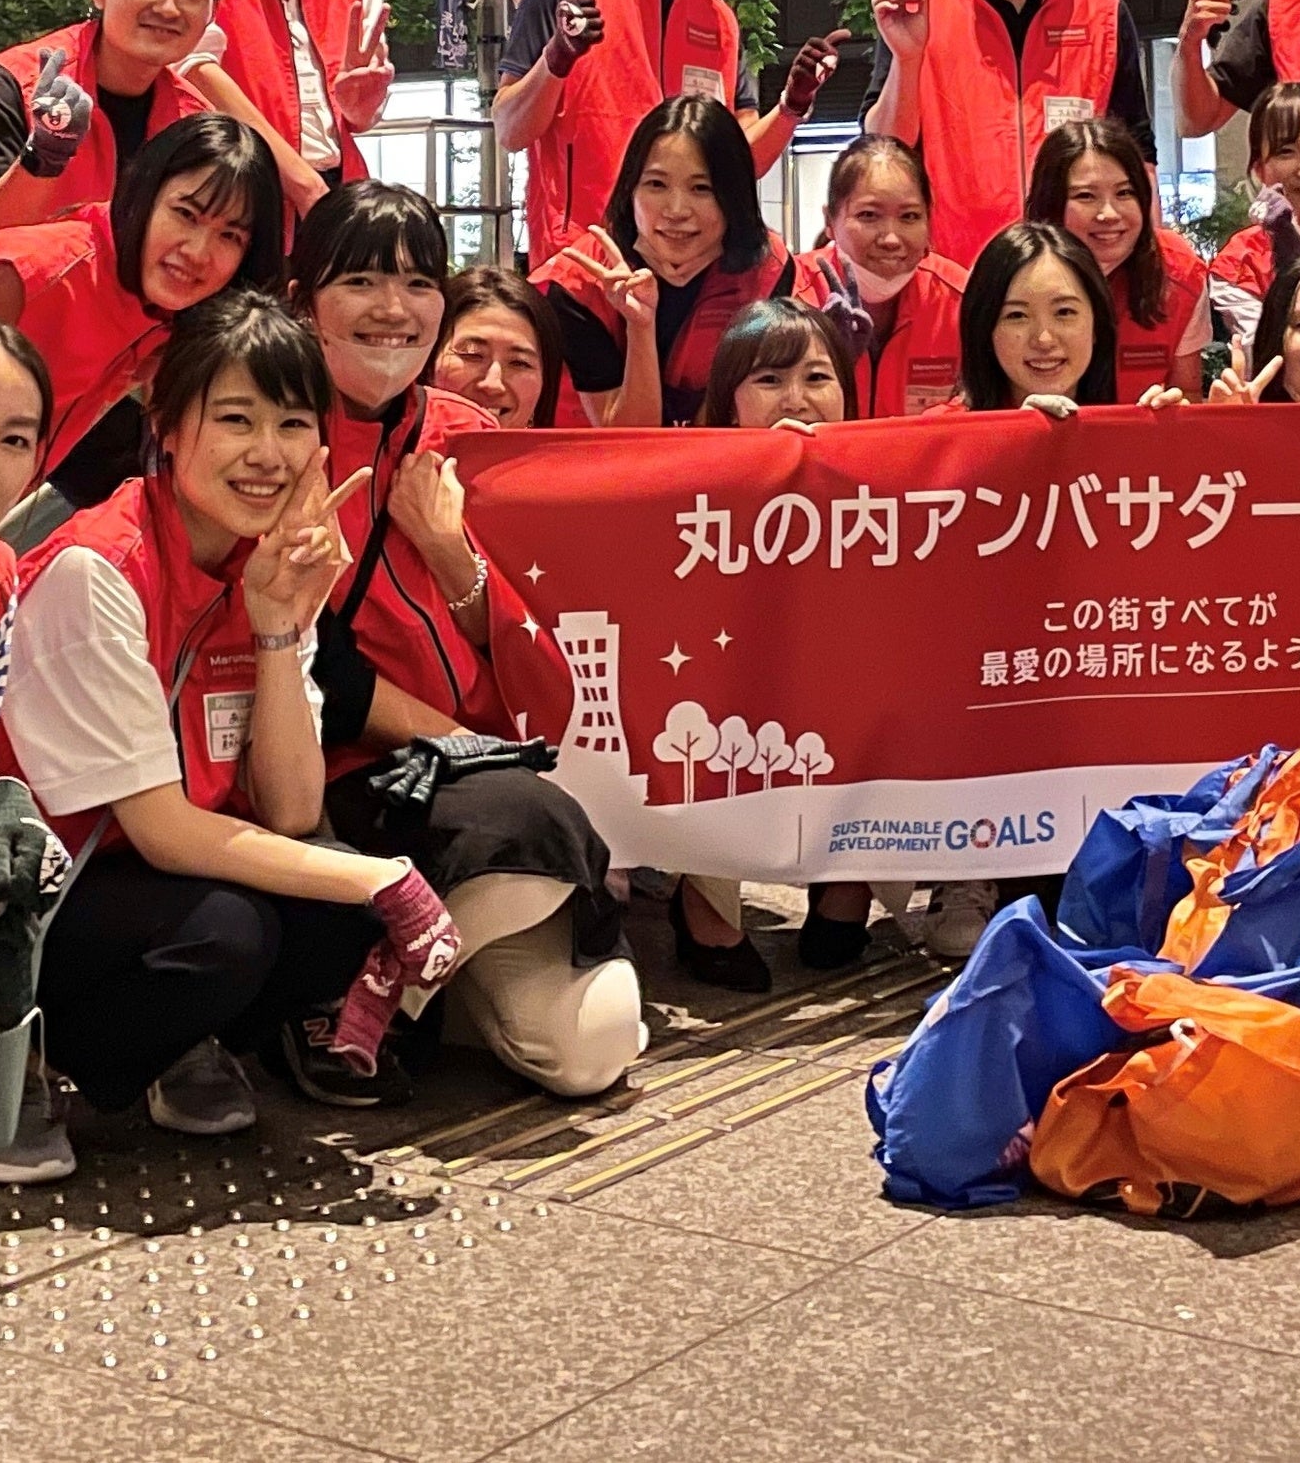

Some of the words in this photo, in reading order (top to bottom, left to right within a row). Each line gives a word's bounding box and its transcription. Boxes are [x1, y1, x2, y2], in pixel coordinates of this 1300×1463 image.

[1043, 591, 1278, 632] この街すべてが
[828, 836, 940, 853] DEVELOPMENT
[944, 810, 1056, 850] GOALS
[831, 819, 943, 838] SUSTAINABLE
